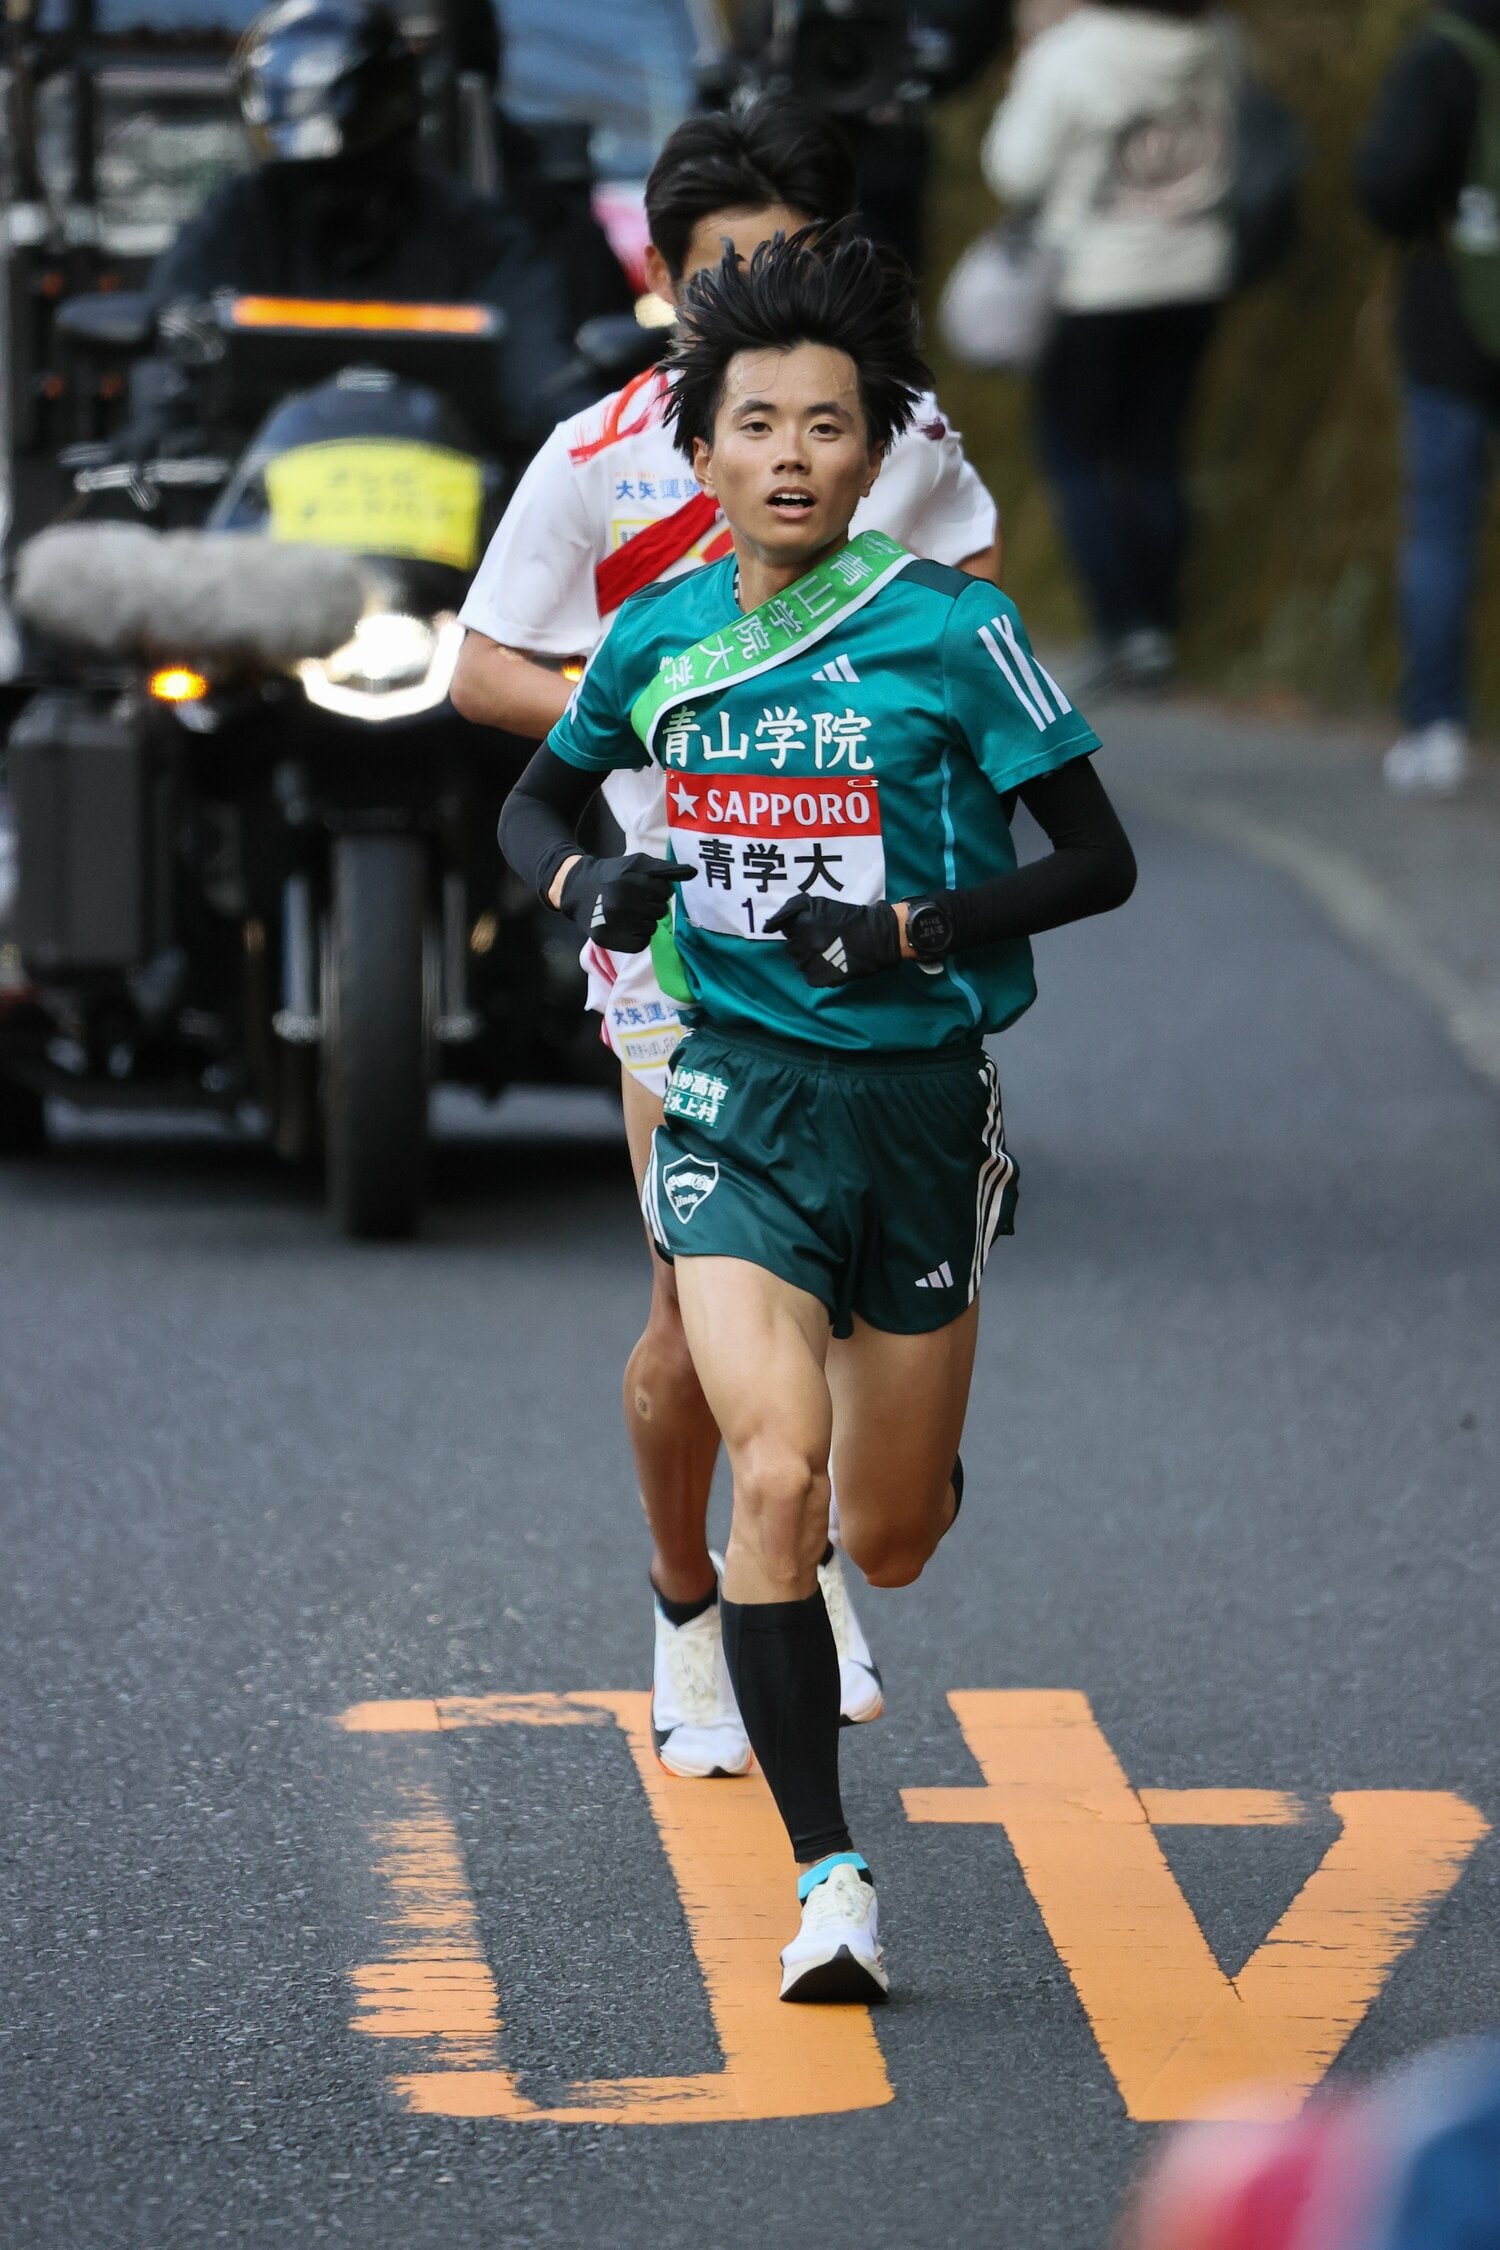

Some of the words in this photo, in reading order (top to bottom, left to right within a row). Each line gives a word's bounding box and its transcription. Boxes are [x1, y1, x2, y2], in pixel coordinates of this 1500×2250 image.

[663, 551, 874, 691] 青山学院大学
[662, 706, 875, 771] 青山学院
[706, 789, 871, 827] SAPPORO
[698, 839, 844, 893] 青学大
